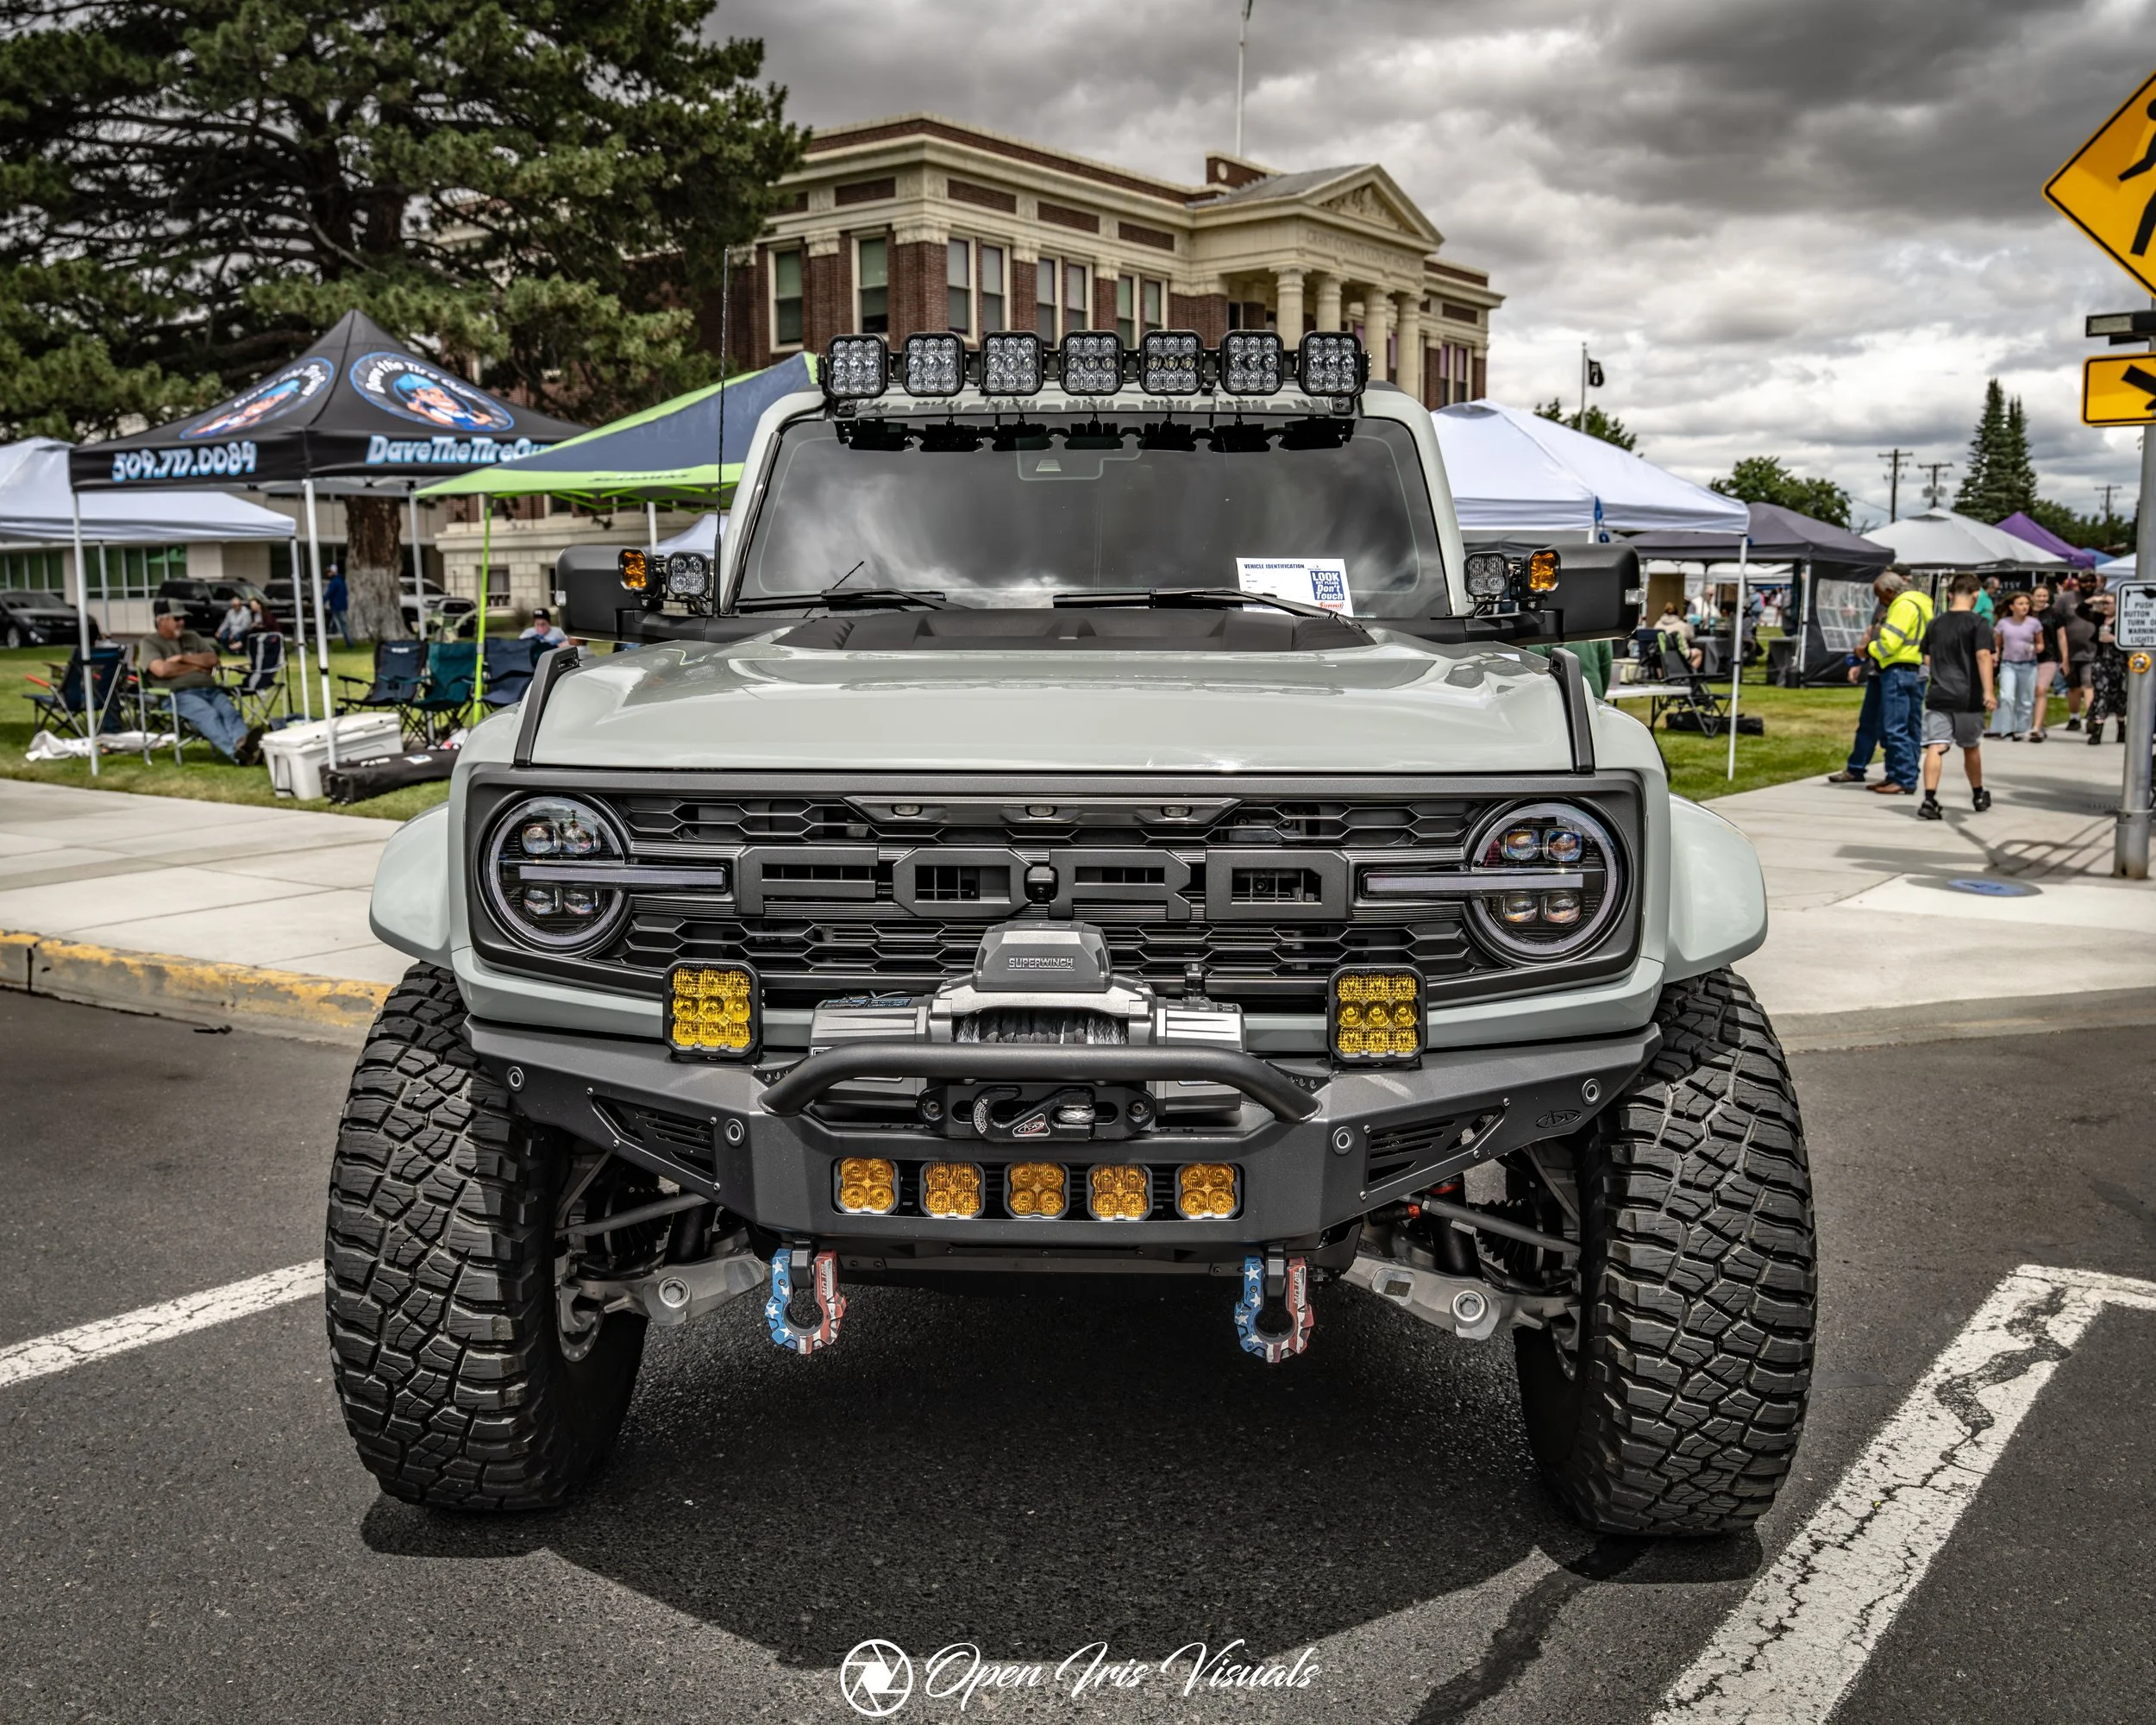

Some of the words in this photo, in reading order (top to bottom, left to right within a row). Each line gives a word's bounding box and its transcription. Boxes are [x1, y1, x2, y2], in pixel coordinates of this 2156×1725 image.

[376, 359, 404, 373] the
[404, 361, 439, 380] Tire
[366, 435, 553, 465] DaveTheTireG
[112, 441, 257, 482] 509.717.0084
[1312, 572, 1340, 581] LOOK
[1315, 591, 1344, 600] Touch
[1317, 584, 1341, 593] Don't
[736, 848, 1349, 920] FORD
[1008, 957, 1074, 969] SUPERWINCH
